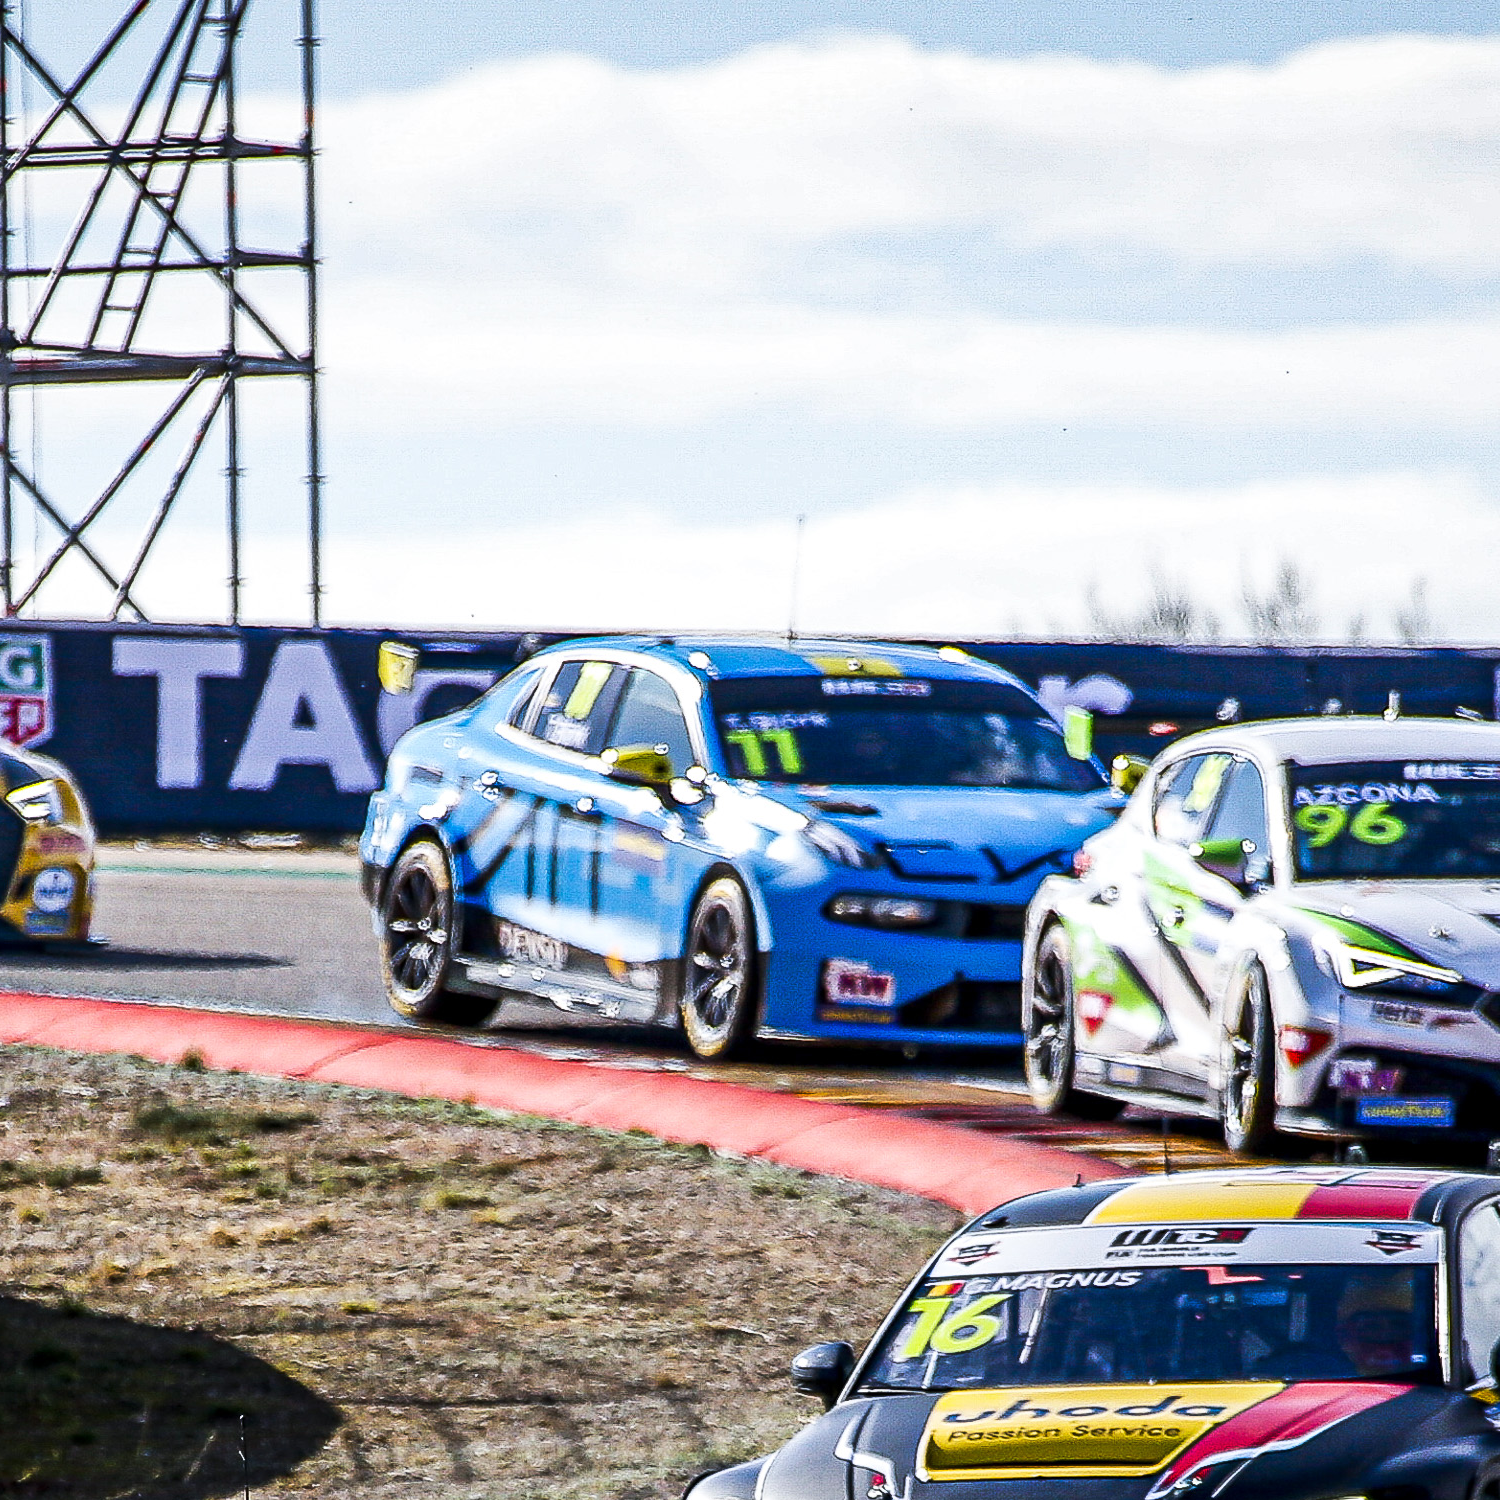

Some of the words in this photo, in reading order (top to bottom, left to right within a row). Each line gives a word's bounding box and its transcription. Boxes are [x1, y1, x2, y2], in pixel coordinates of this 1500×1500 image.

[726, 728, 803, 777] 11
[1295, 801, 1407, 849] 96
[900, 1293, 1014, 1362] 16
[948, 1426, 1061, 1443] Passion
[1071, 1423, 1182, 1440] Service
